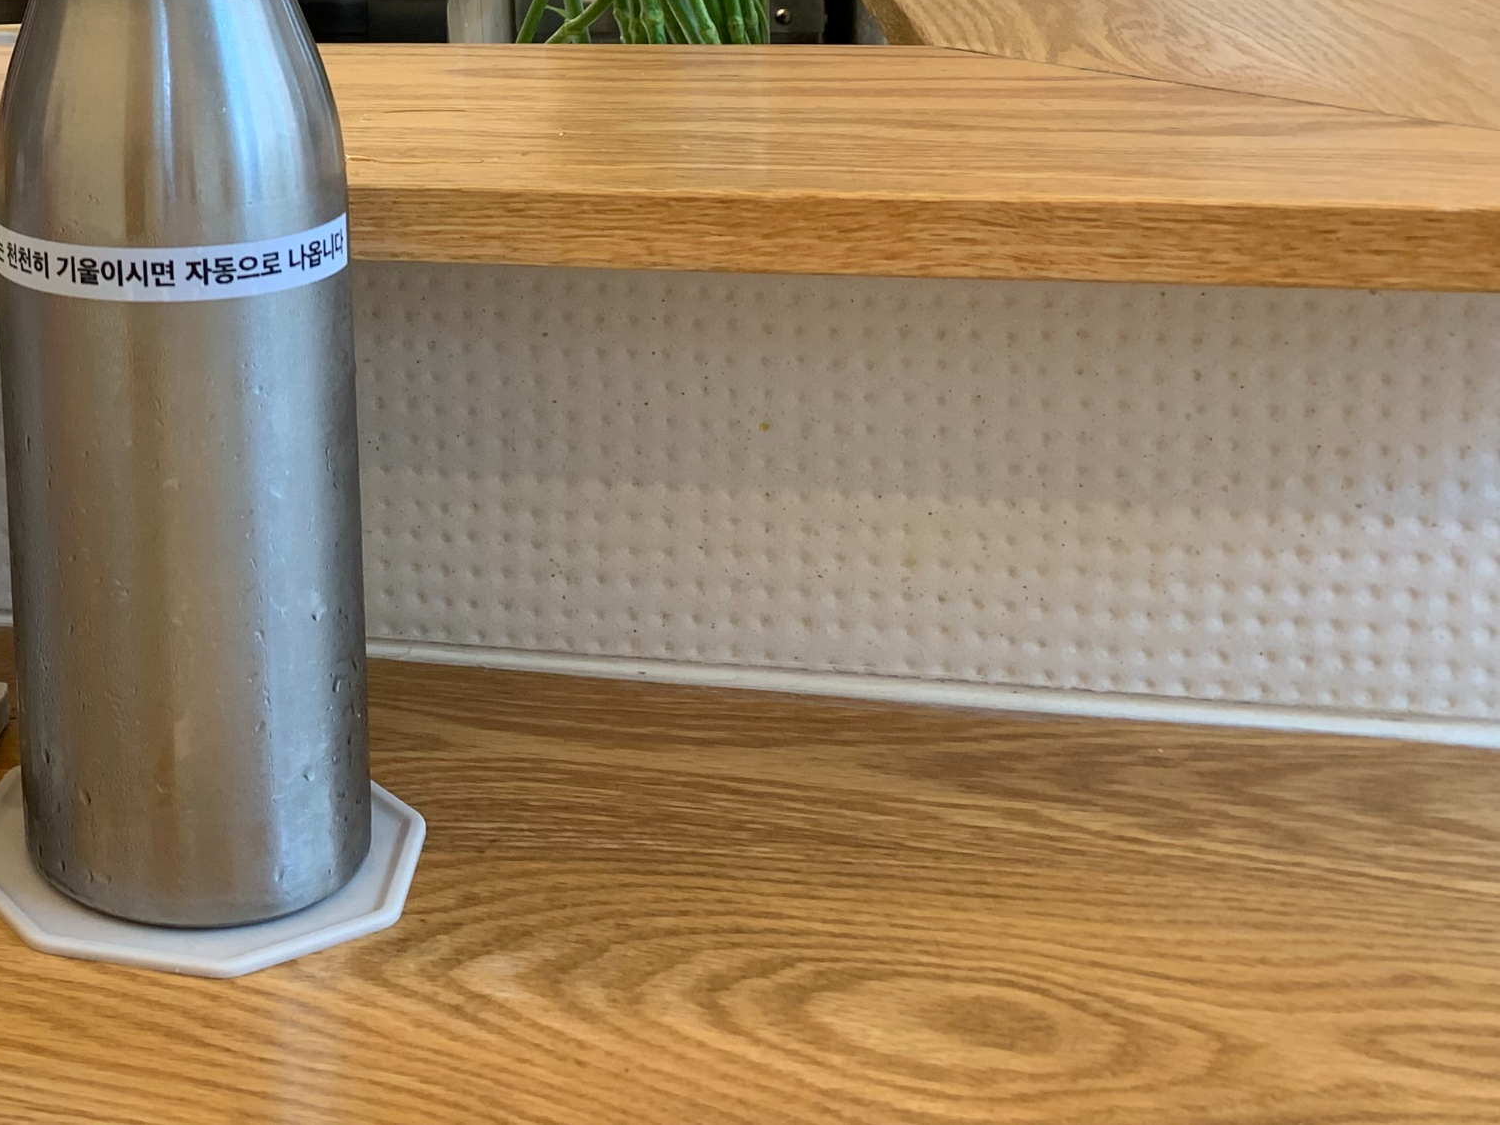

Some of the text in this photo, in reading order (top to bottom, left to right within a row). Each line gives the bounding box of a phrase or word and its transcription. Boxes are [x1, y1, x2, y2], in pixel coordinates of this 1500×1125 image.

[7, 241, 49, 279] 천천히
[55, 256, 176, 288] 기울이시면
[185, 256, 283, 287] 자동으로
[288, 228, 344, 271] 나옵니다
